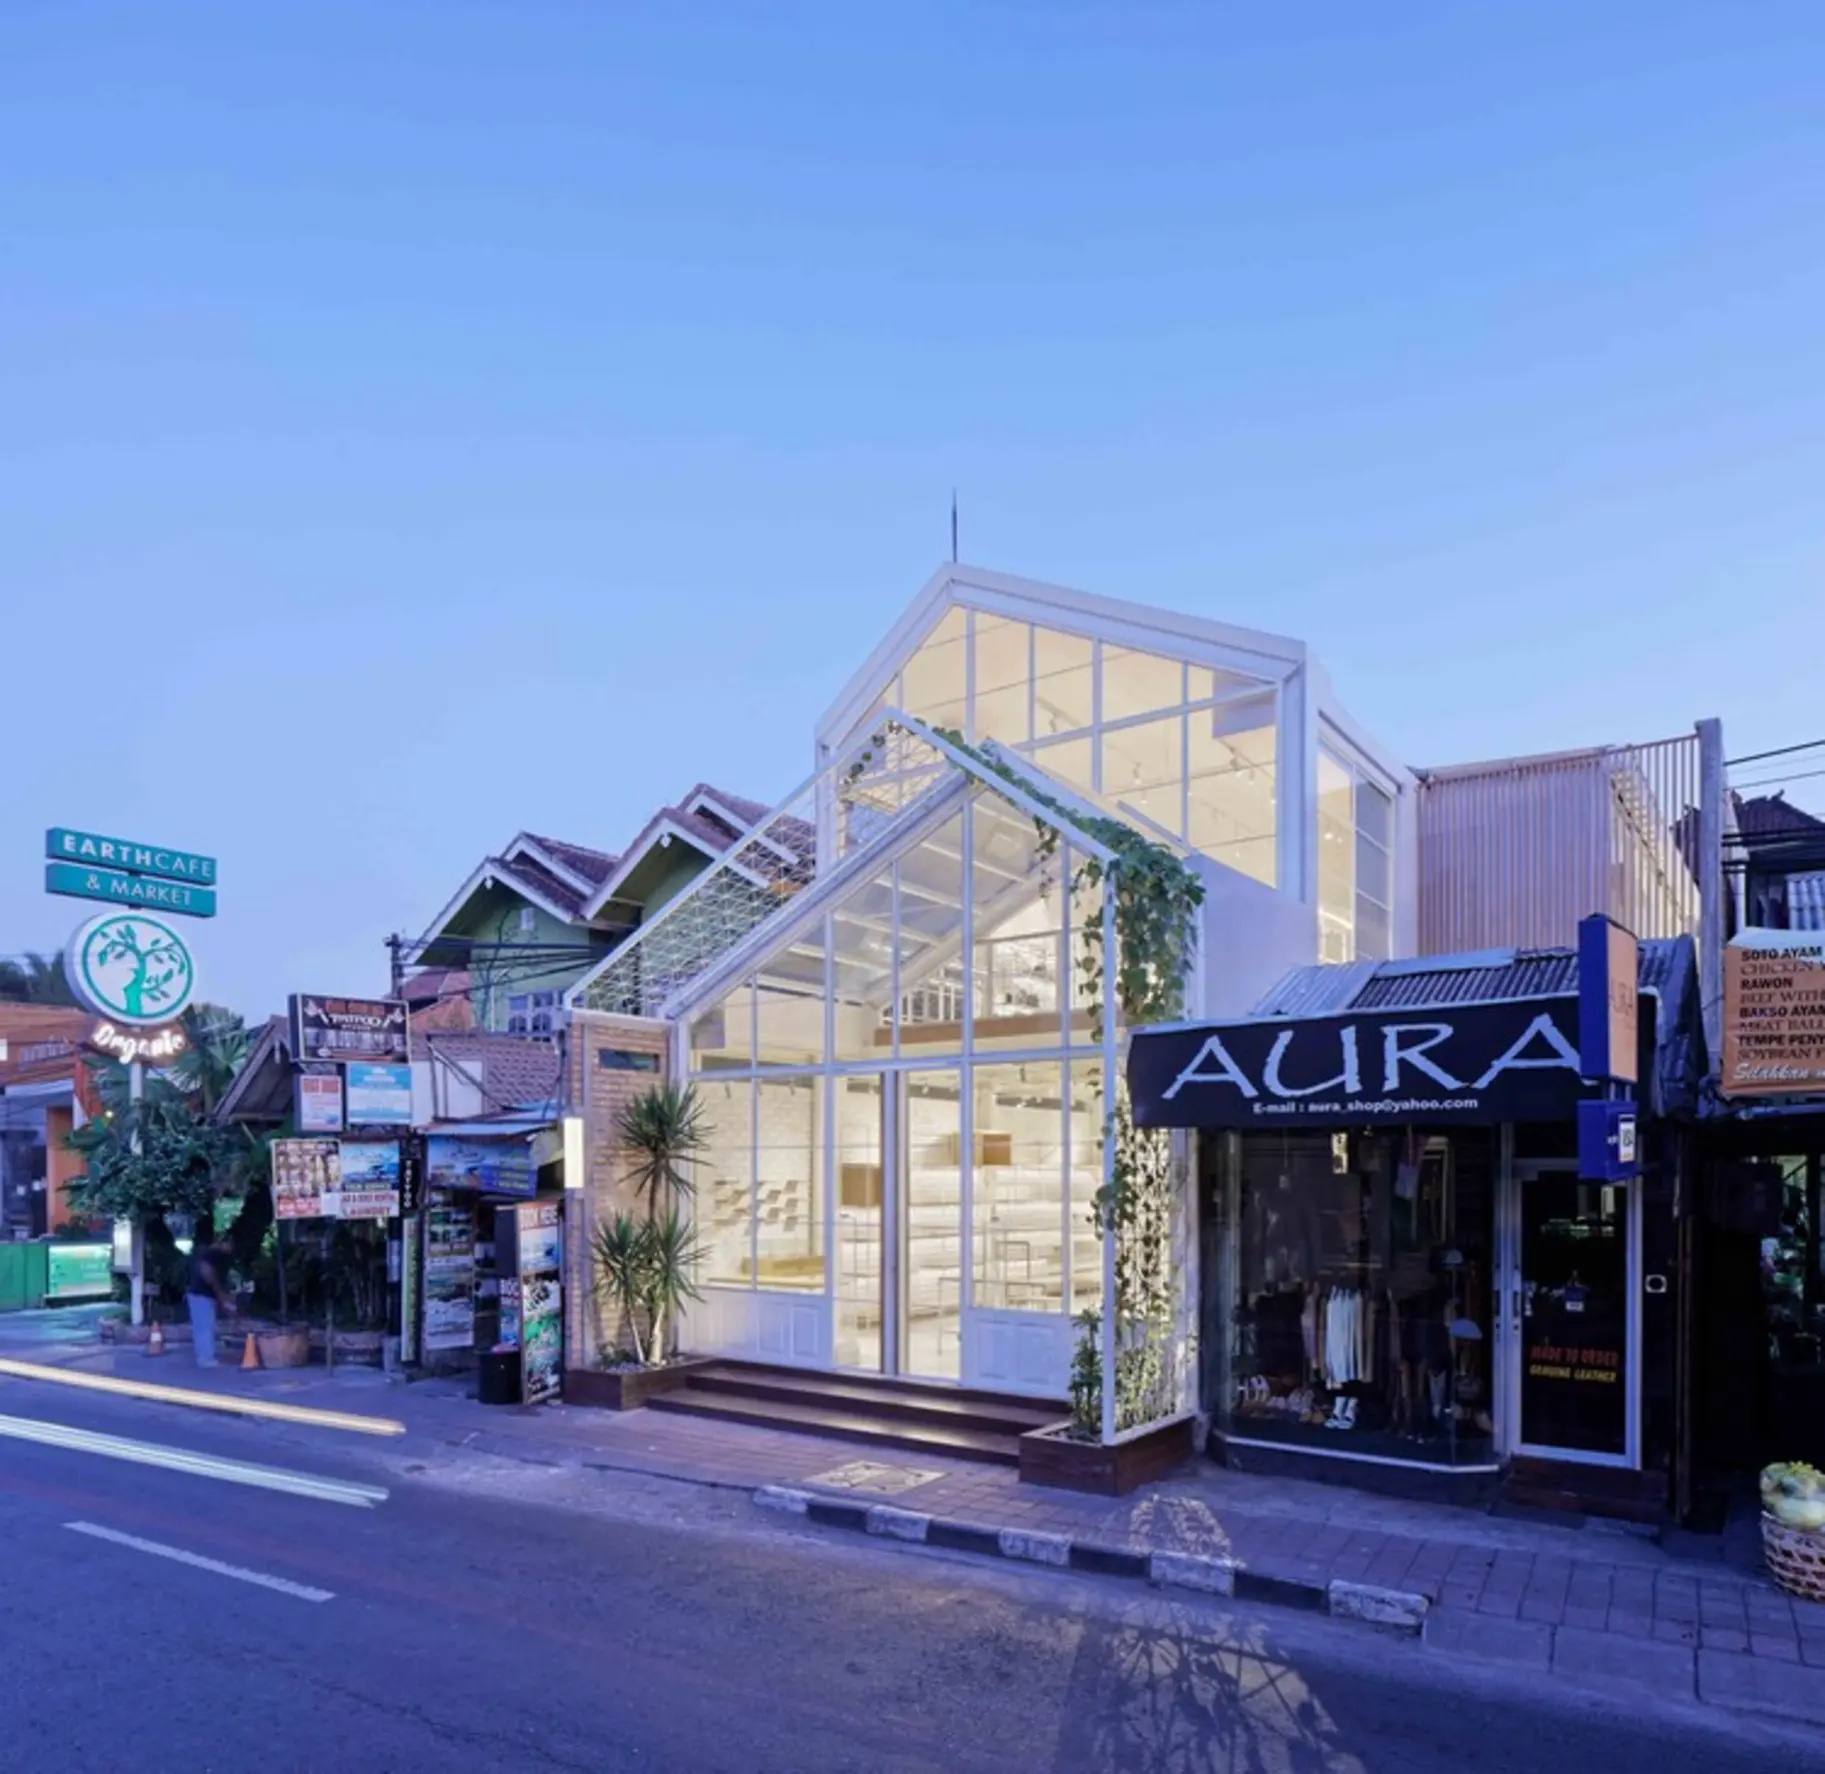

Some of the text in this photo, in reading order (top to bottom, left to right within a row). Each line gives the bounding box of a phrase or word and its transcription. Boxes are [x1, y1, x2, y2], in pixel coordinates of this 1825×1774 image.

[63, 834, 212, 877] EARTHCAFE
[86, 874, 192, 906] & MARKET
[1741, 945, 1823, 962] SOTO AYAM
[1740, 960, 1814, 975] CHICKEN
[1740, 976, 1793, 990] RAWON
[1740, 991, 1777, 1004] BEEF
[1739, 1006, 1788, 1018] BAKSO
[1740, 1020, 1785, 1032] MEAT
[92, 1023, 186, 1065] Organic
[1738, 1033, 1786, 1046] TEMPE
[1161, 1012, 1599, 1099] AURA
[1738, 1048, 1812, 1061] SOYBEAN
[1253, 1102, 1296, 1114] E-mail
[1308, 1098, 1479, 1114] aura_shop@yahoo.com
